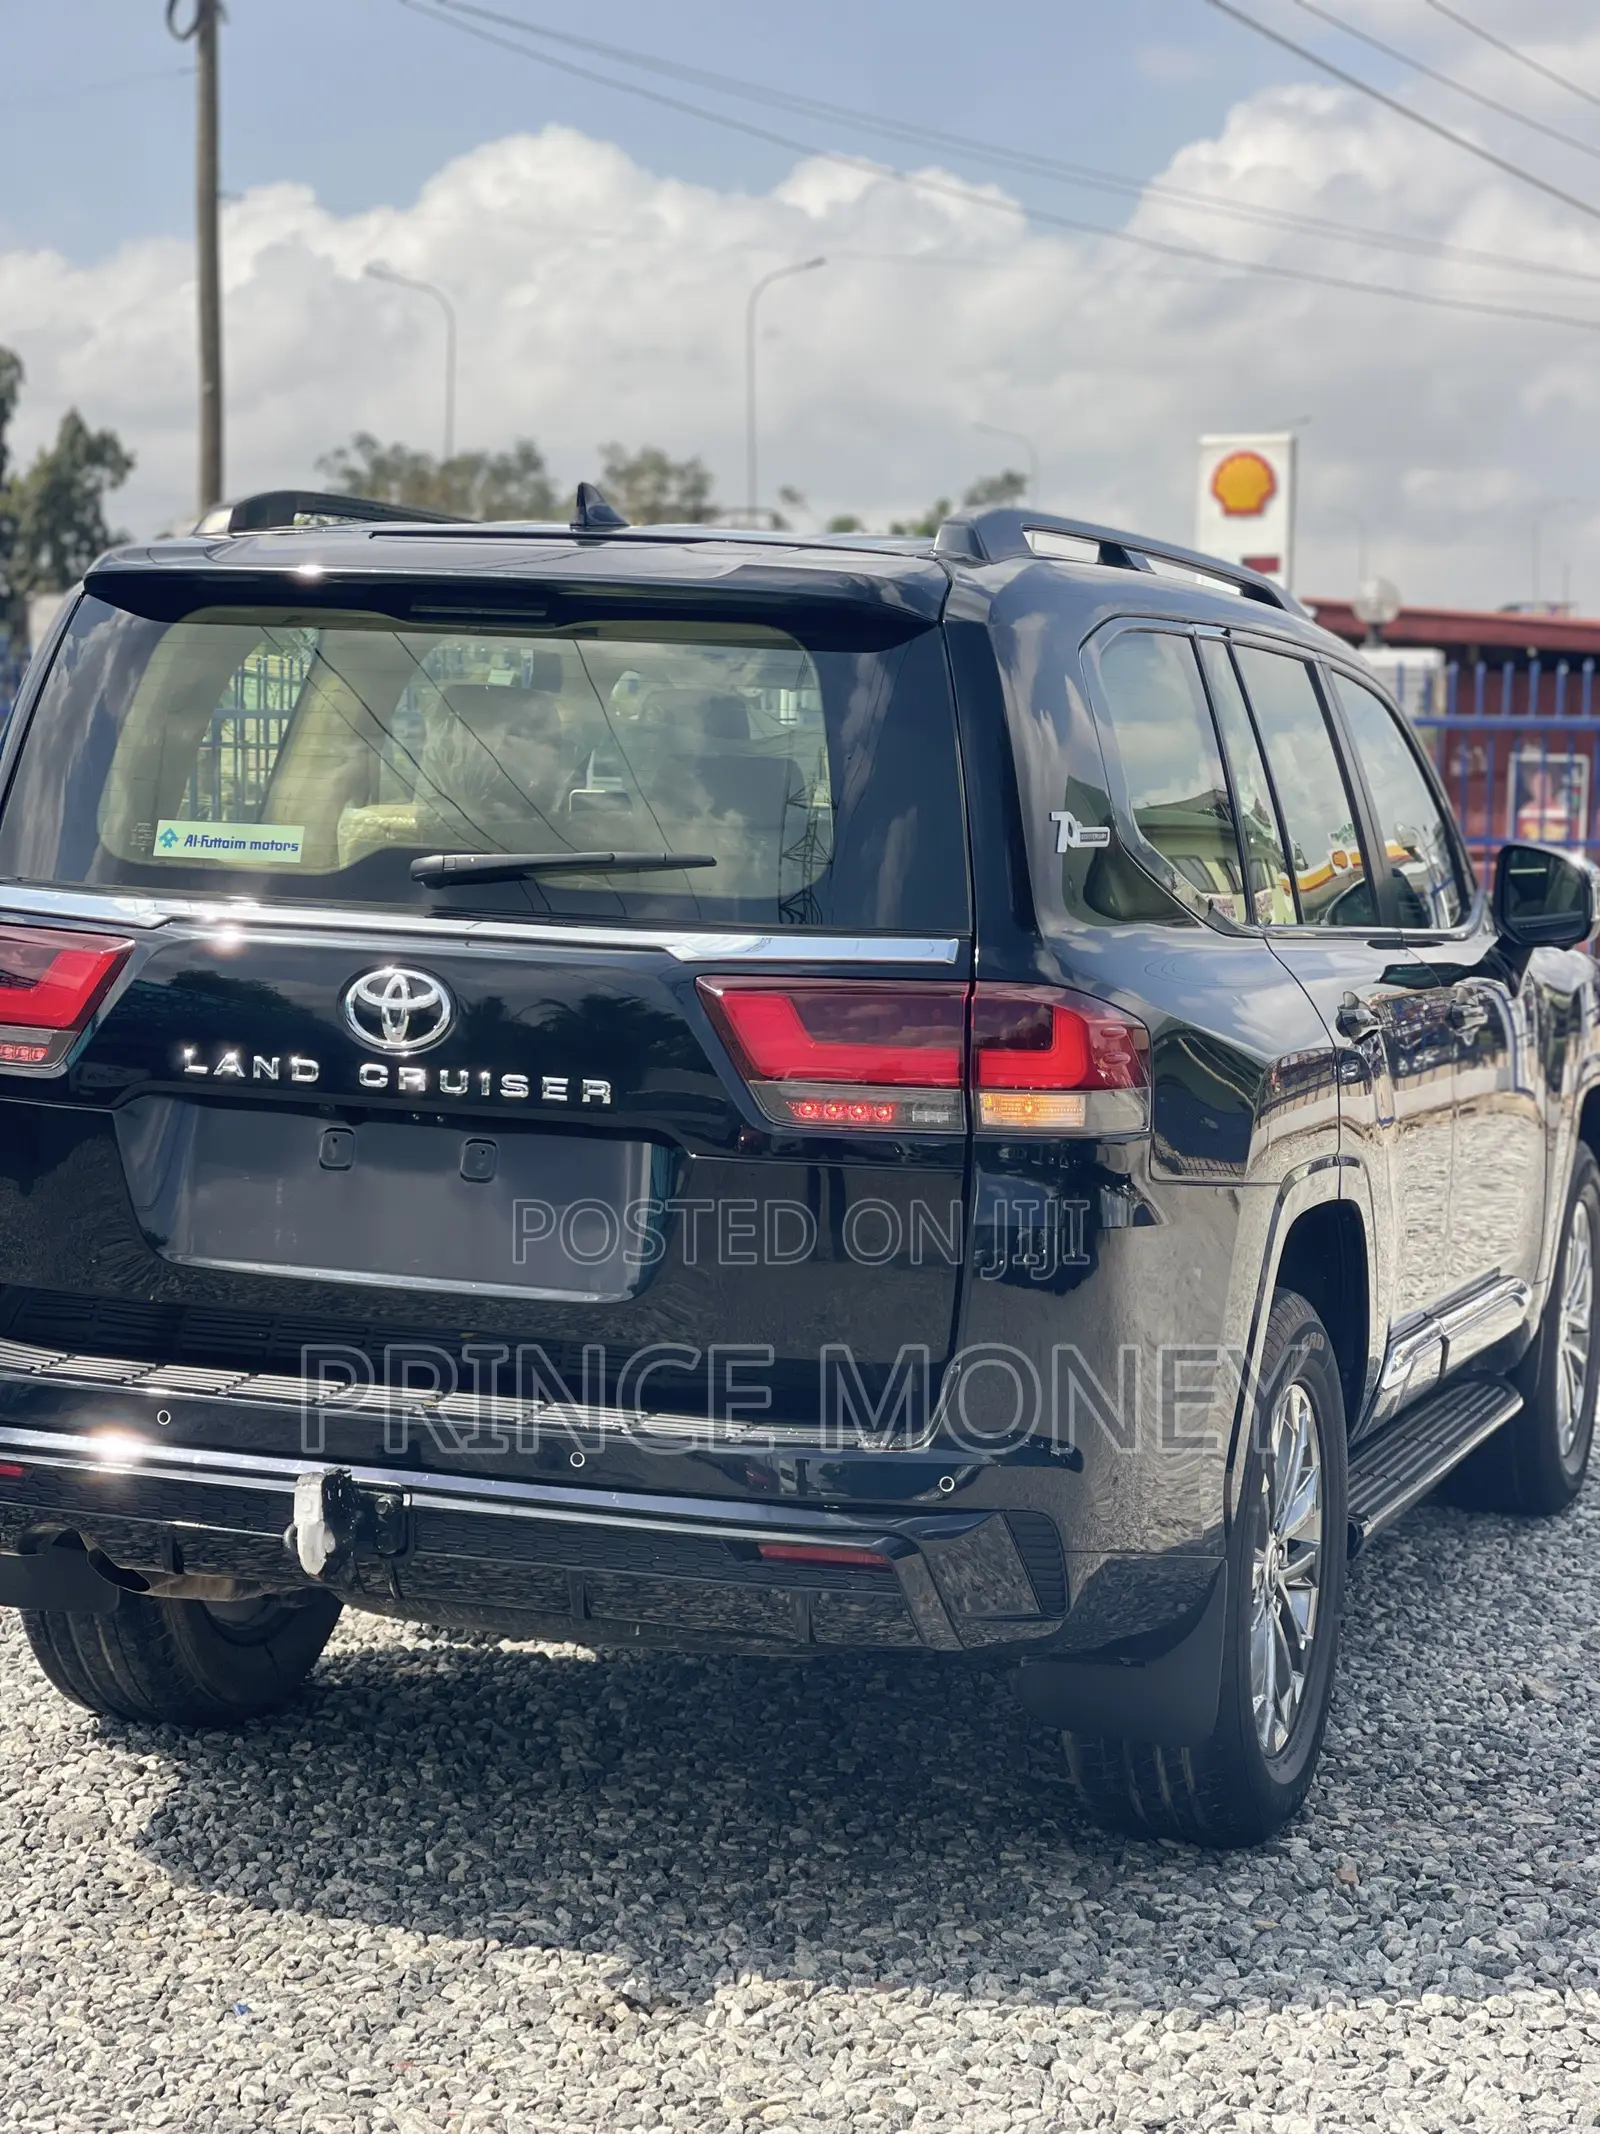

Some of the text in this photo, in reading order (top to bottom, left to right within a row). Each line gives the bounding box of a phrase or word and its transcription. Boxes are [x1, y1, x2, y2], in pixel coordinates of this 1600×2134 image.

[184, 834, 299, 852] Al-Futtaim motors
[183, 1047, 612, 1104] LAND CRUISER
